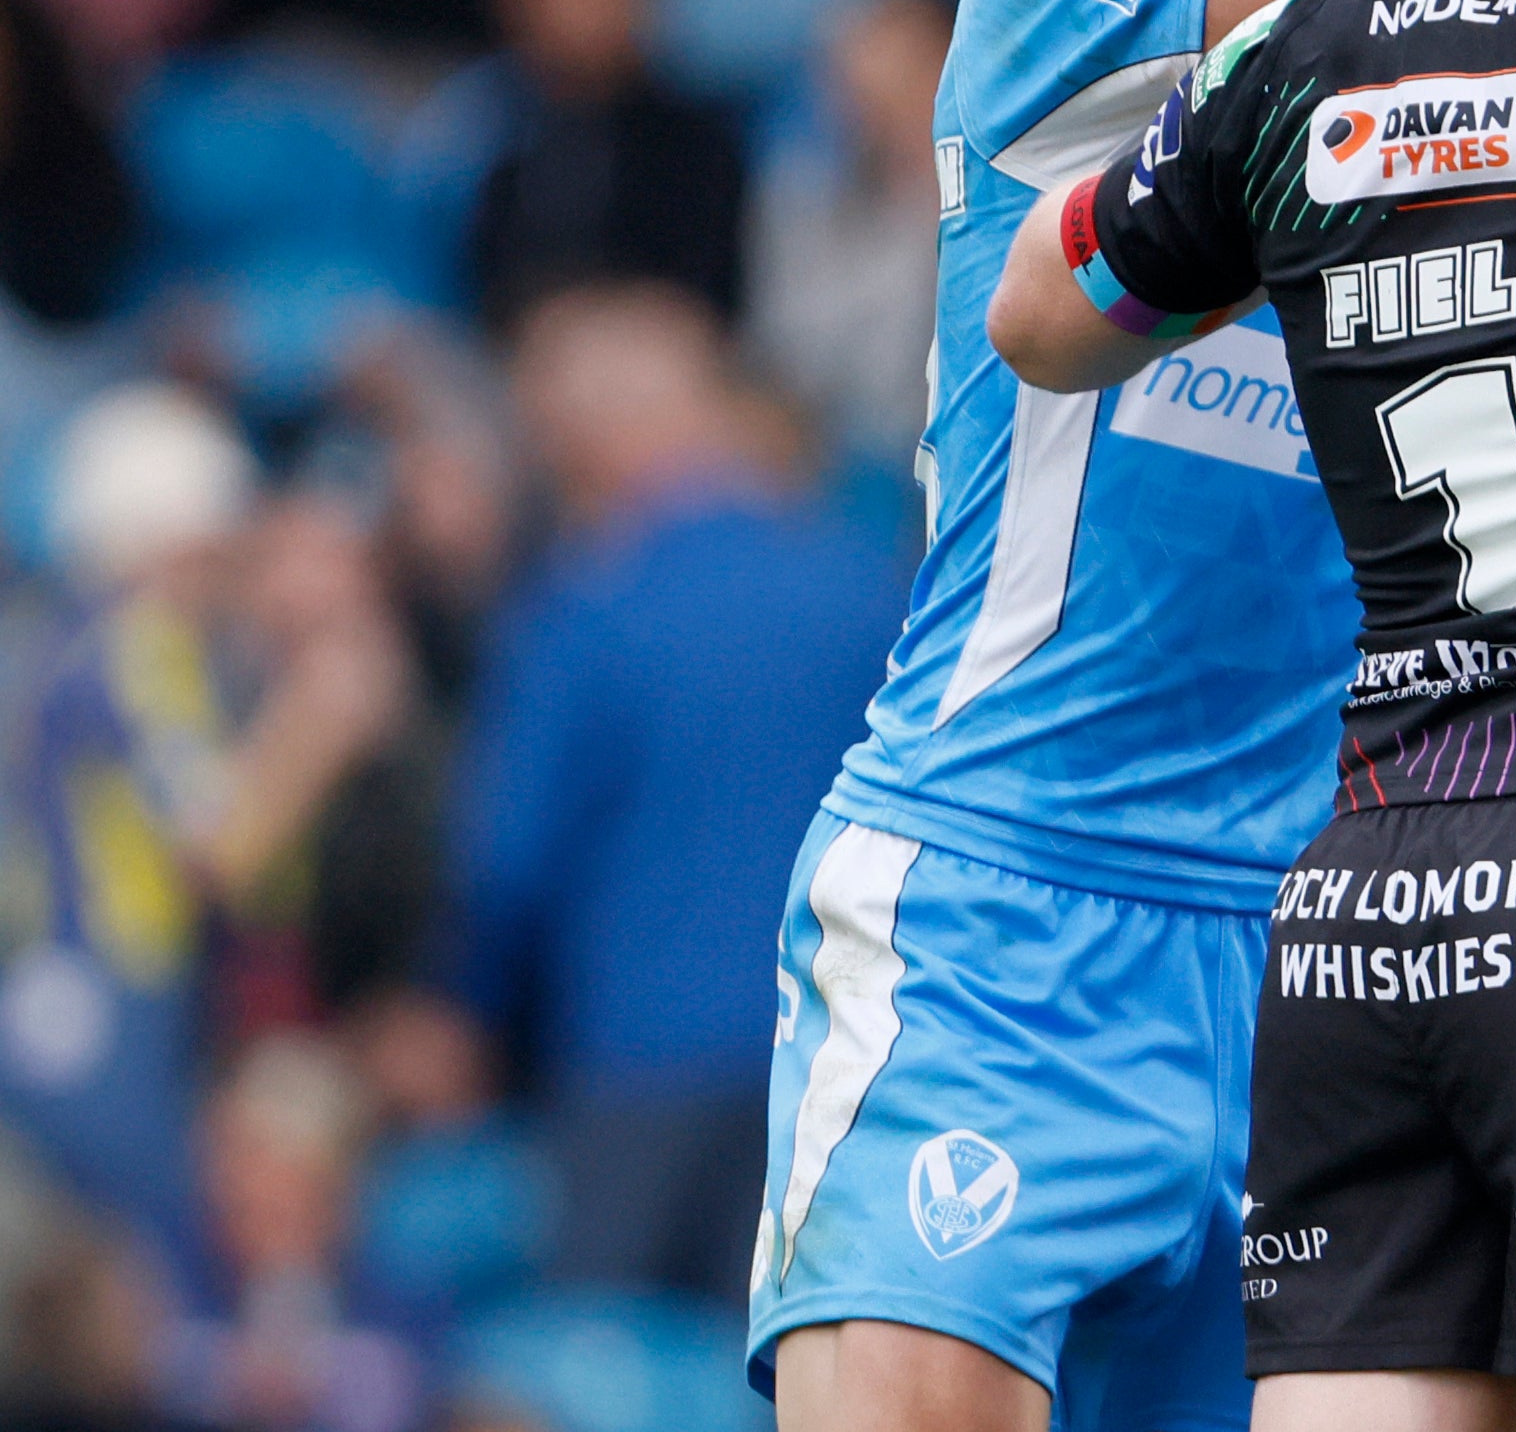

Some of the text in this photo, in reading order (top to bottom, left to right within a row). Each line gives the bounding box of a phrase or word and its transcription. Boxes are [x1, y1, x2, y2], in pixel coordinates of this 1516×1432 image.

[1379, 134, 1510, 179] TYRES
[1457, 674, 1474, 695] &
[1280, 932, 1514, 1004] WHISKIES
